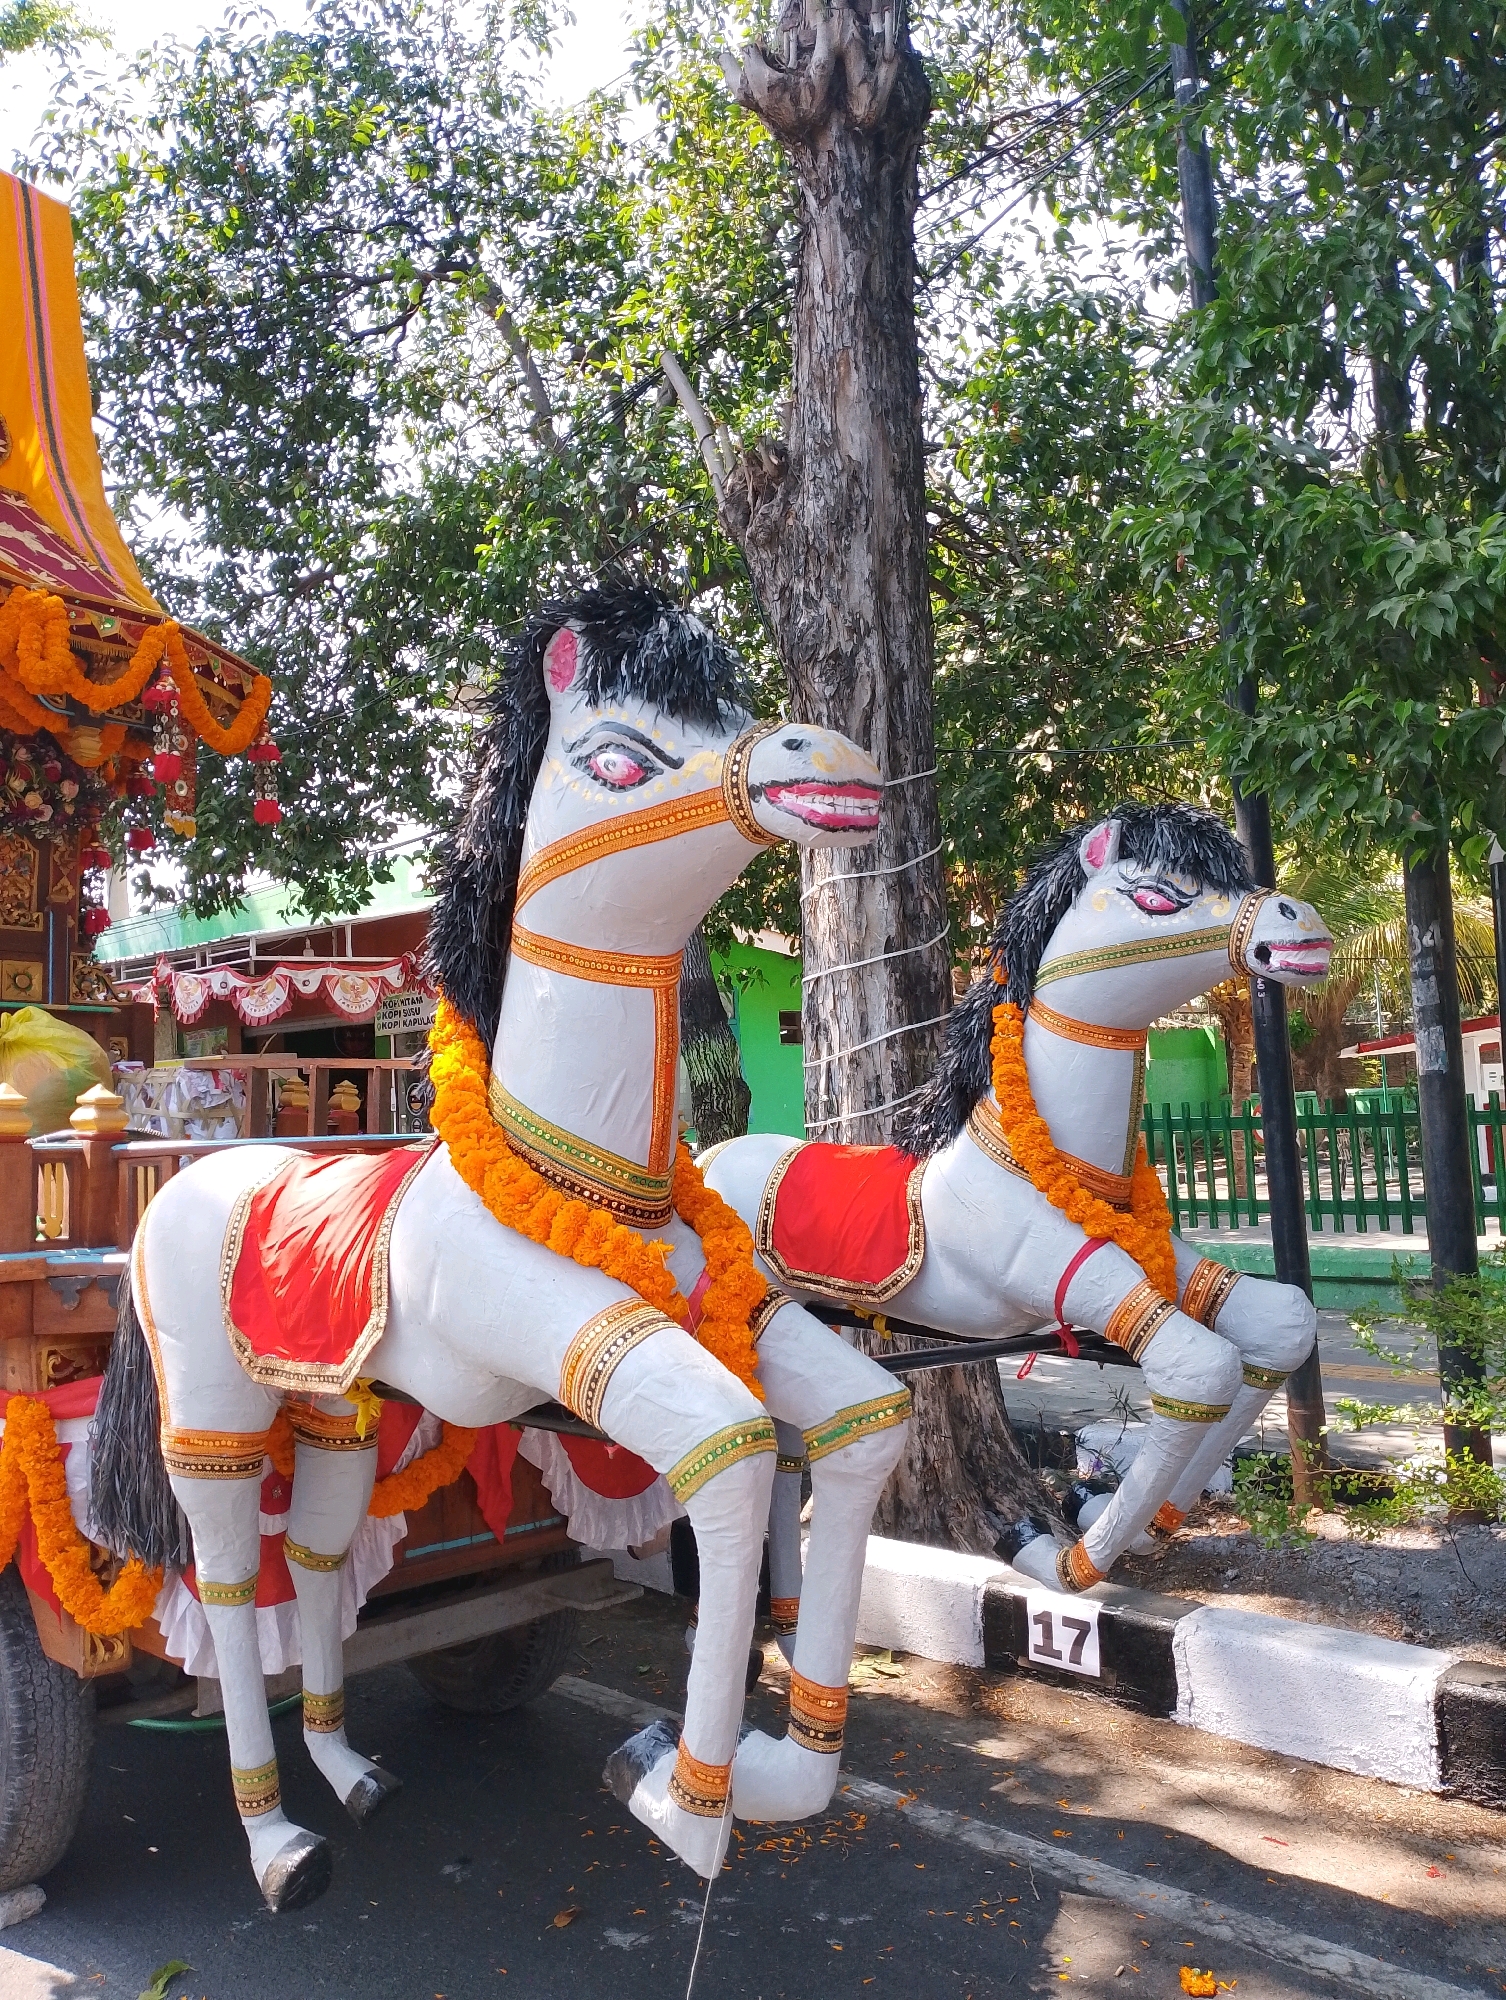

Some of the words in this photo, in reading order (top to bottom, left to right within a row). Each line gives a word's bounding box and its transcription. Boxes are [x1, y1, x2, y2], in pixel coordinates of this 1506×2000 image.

[382, 999, 400, 1009] KOPI
[400, 996, 424, 1006] HITAM
[382, 1010, 401, 1020] KOPI
[402, 1007, 421, 1017] SUSU
[381, 1020, 401, 1030] KOPI
[1032, 1609, 1092, 1667] 17
